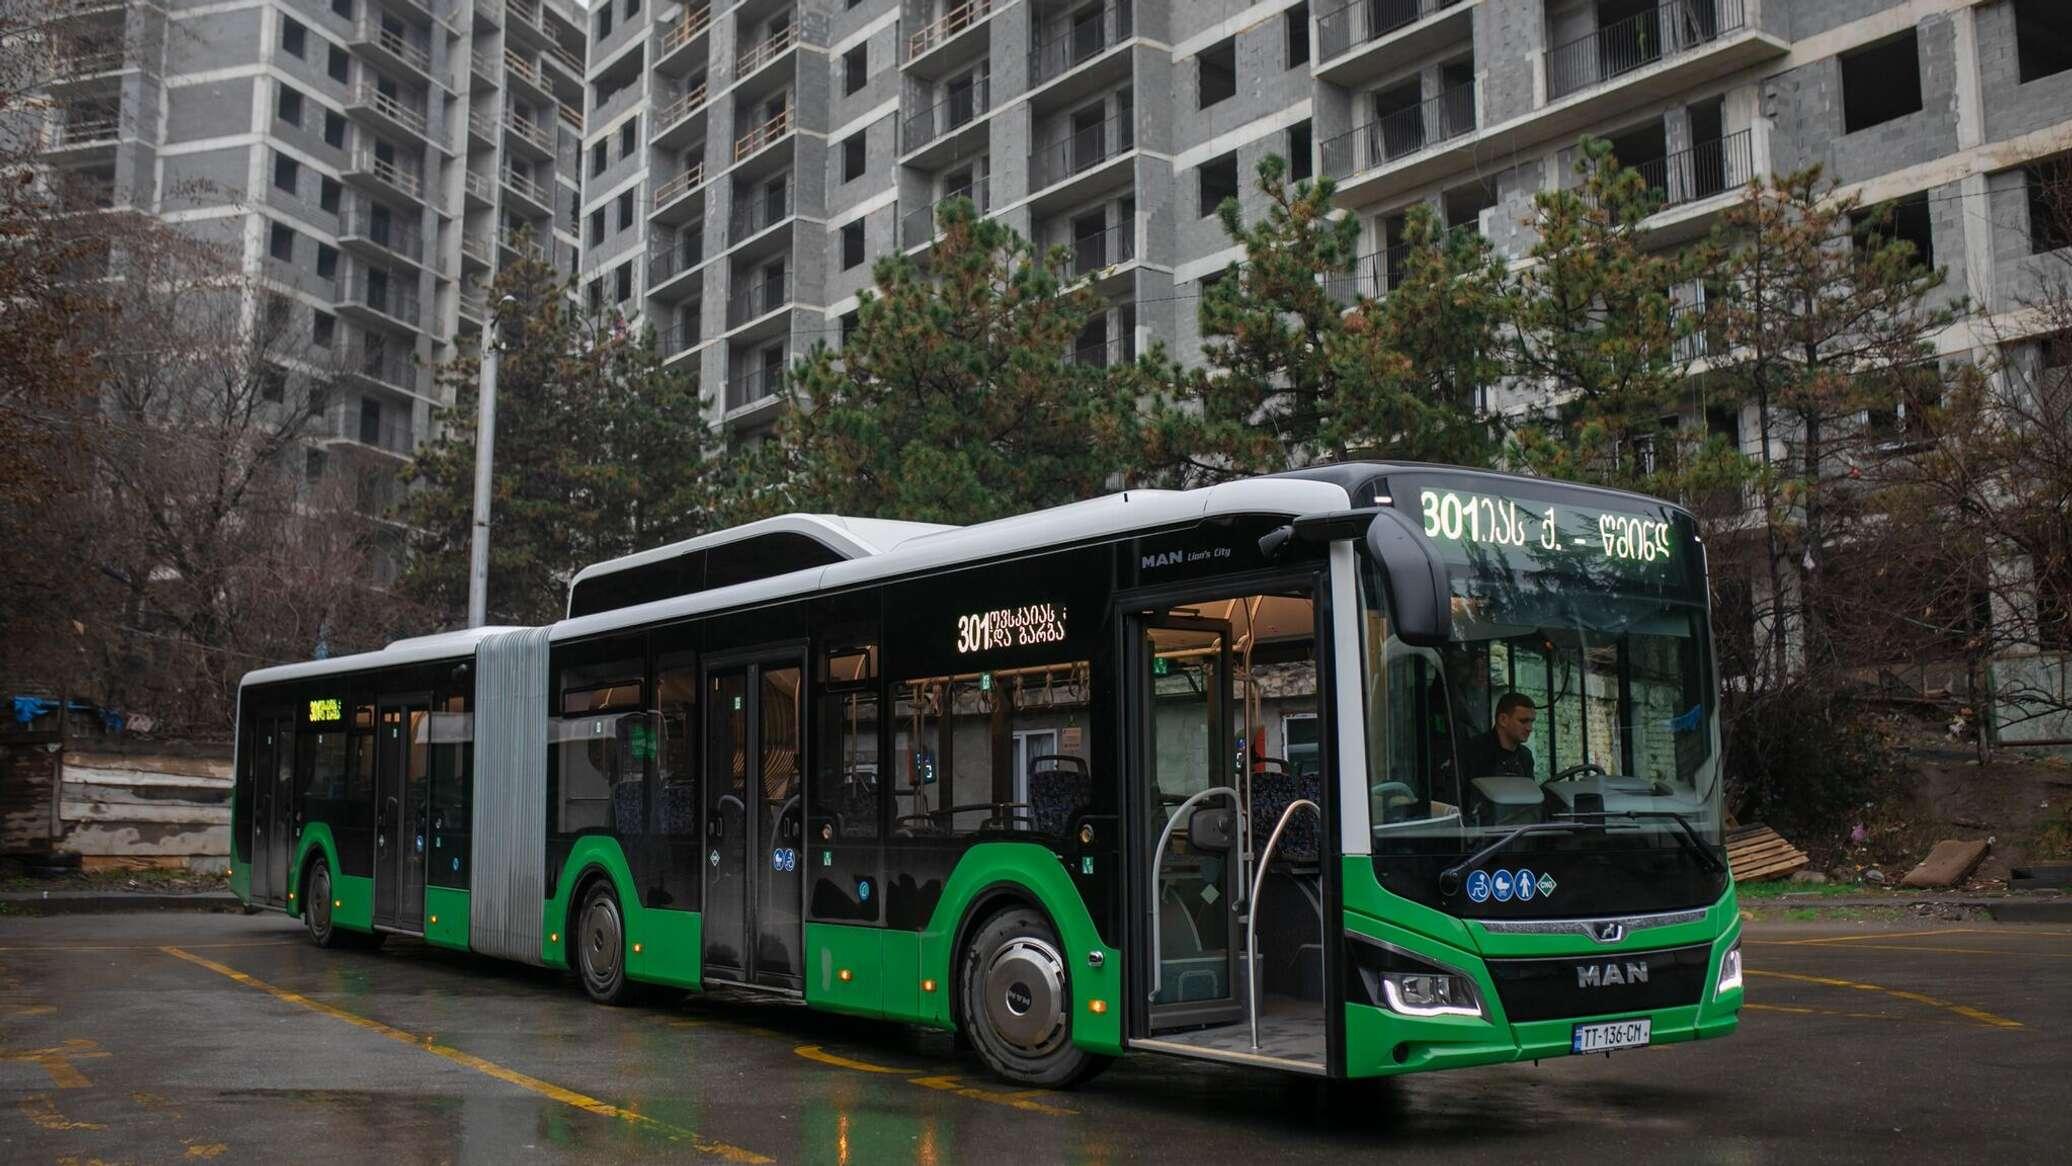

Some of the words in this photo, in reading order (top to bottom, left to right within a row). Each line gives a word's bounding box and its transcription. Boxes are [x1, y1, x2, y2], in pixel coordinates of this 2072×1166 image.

[1421, 491, 1478, 542] 301
[1142, 550, 1183, 569] MAN
[1187, 550, 1211, 561] Lion's
[1214, 547, 1231, 558] City
[958, 613, 990, 653] 301
[1576, 961, 1649, 988] MAN
[1584, 1023, 1642, 1047] TT-136-CM
